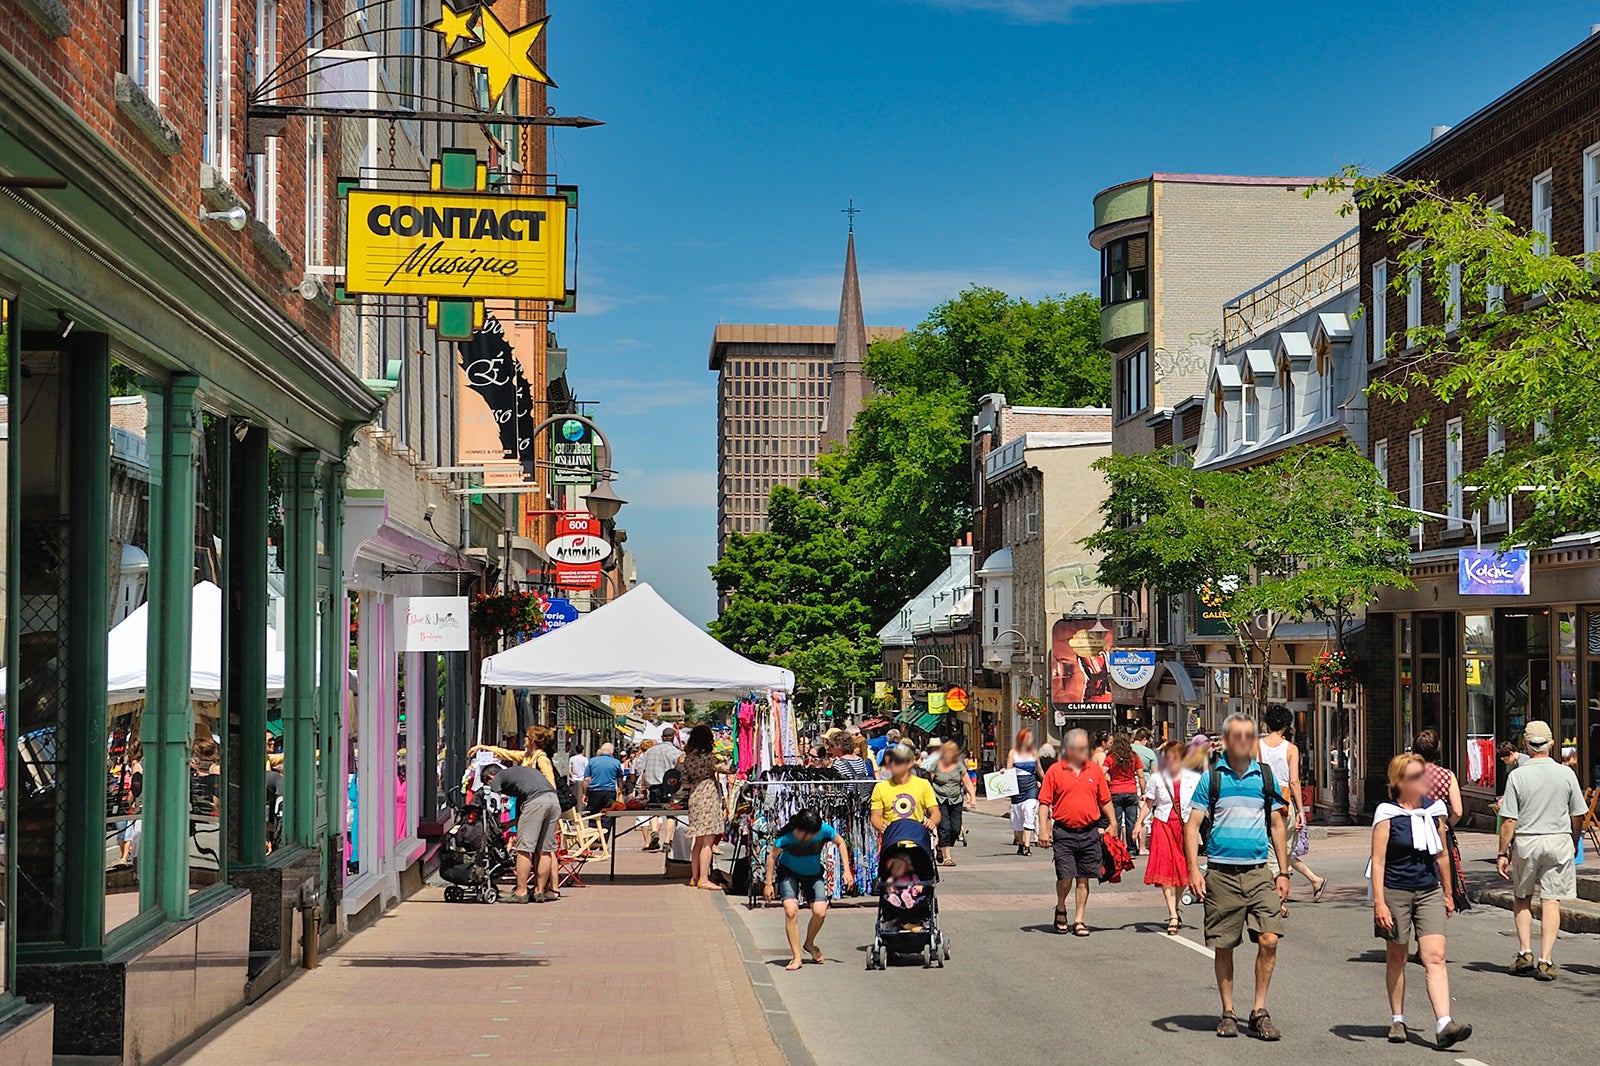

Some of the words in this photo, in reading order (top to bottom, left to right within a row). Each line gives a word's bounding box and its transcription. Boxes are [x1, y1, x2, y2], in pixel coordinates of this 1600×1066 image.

[367, 205, 546, 242] CONTACT
[384, 241, 519, 288] Musique
[569, 520, 588, 530] 600
[425, 614, 431, 625] &
[1421, 683, 1441, 693] DETOX
